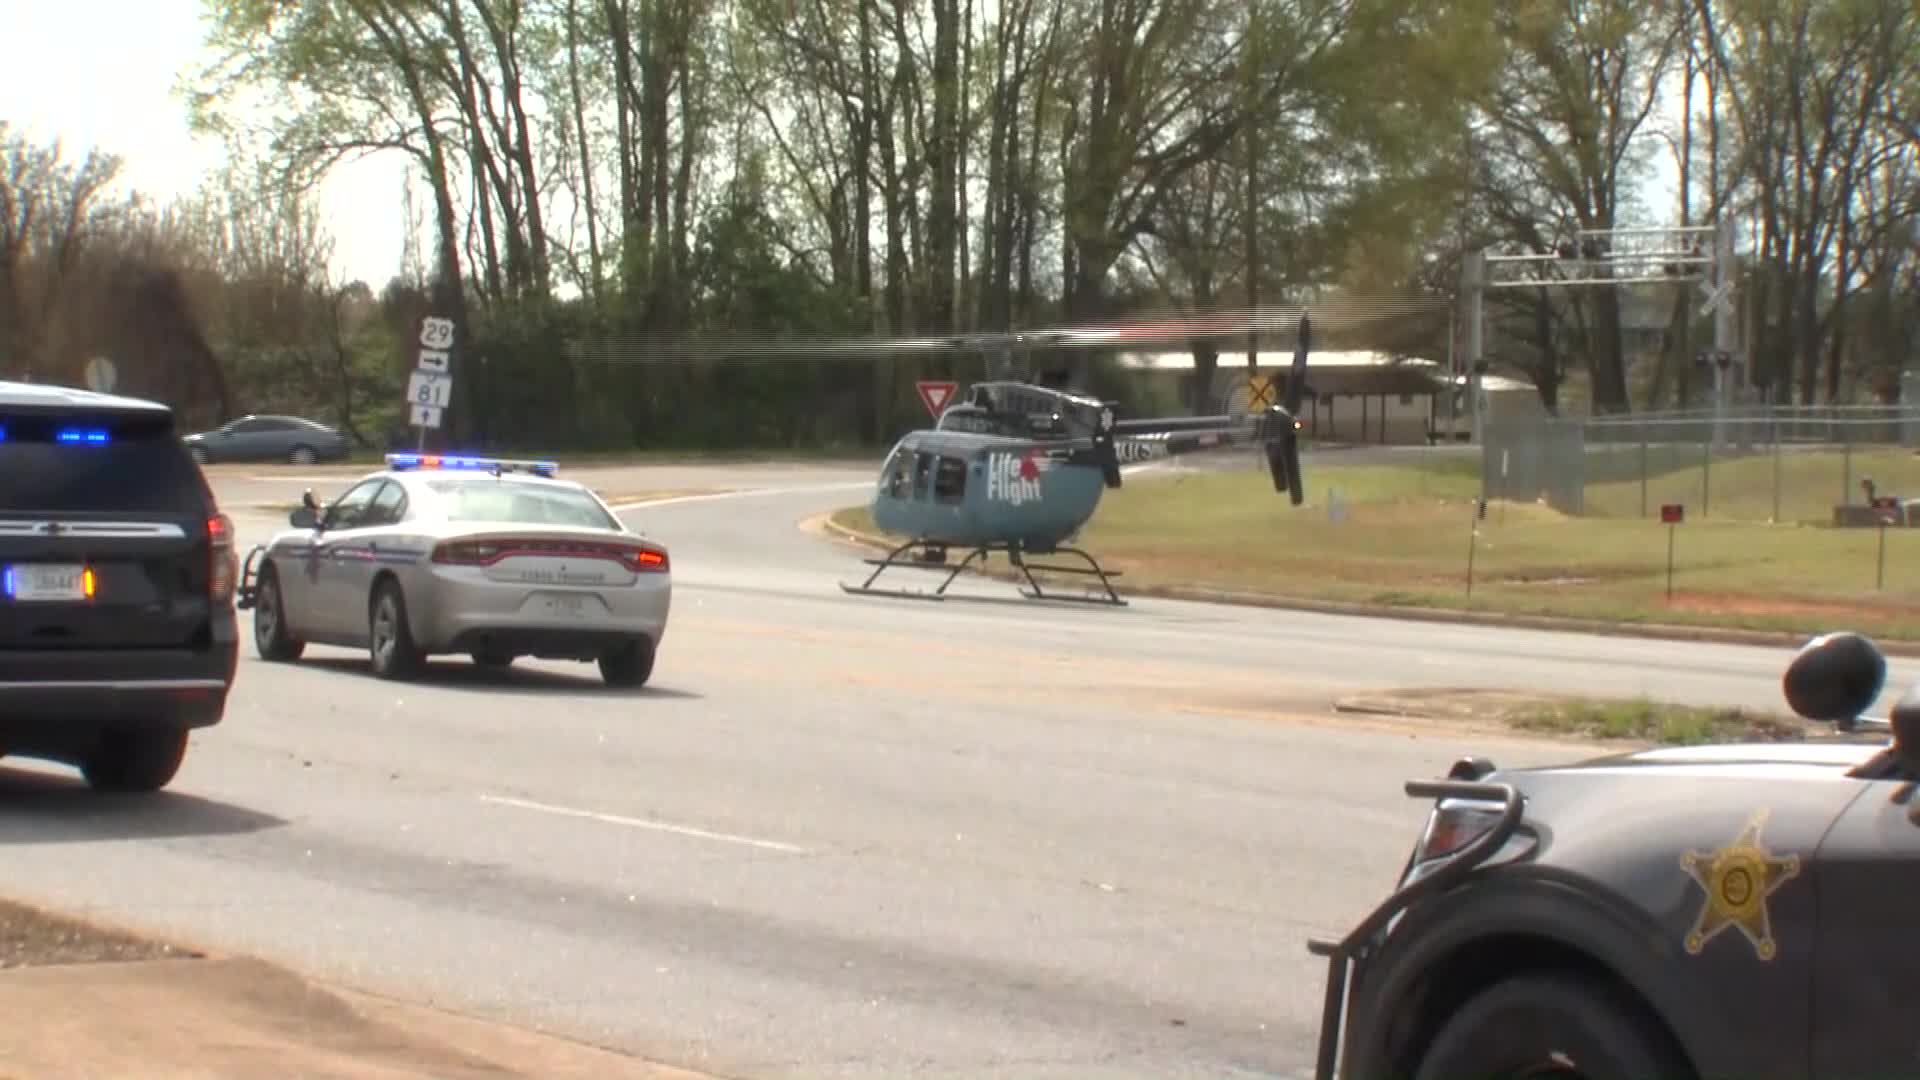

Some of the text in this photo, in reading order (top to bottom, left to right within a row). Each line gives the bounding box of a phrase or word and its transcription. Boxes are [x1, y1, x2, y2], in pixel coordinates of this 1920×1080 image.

[426, 322, 450, 342] 29
[418, 384, 441, 404] 81
[990, 452, 1021, 479] Life
[988, 477, 1042, 506] Flight
